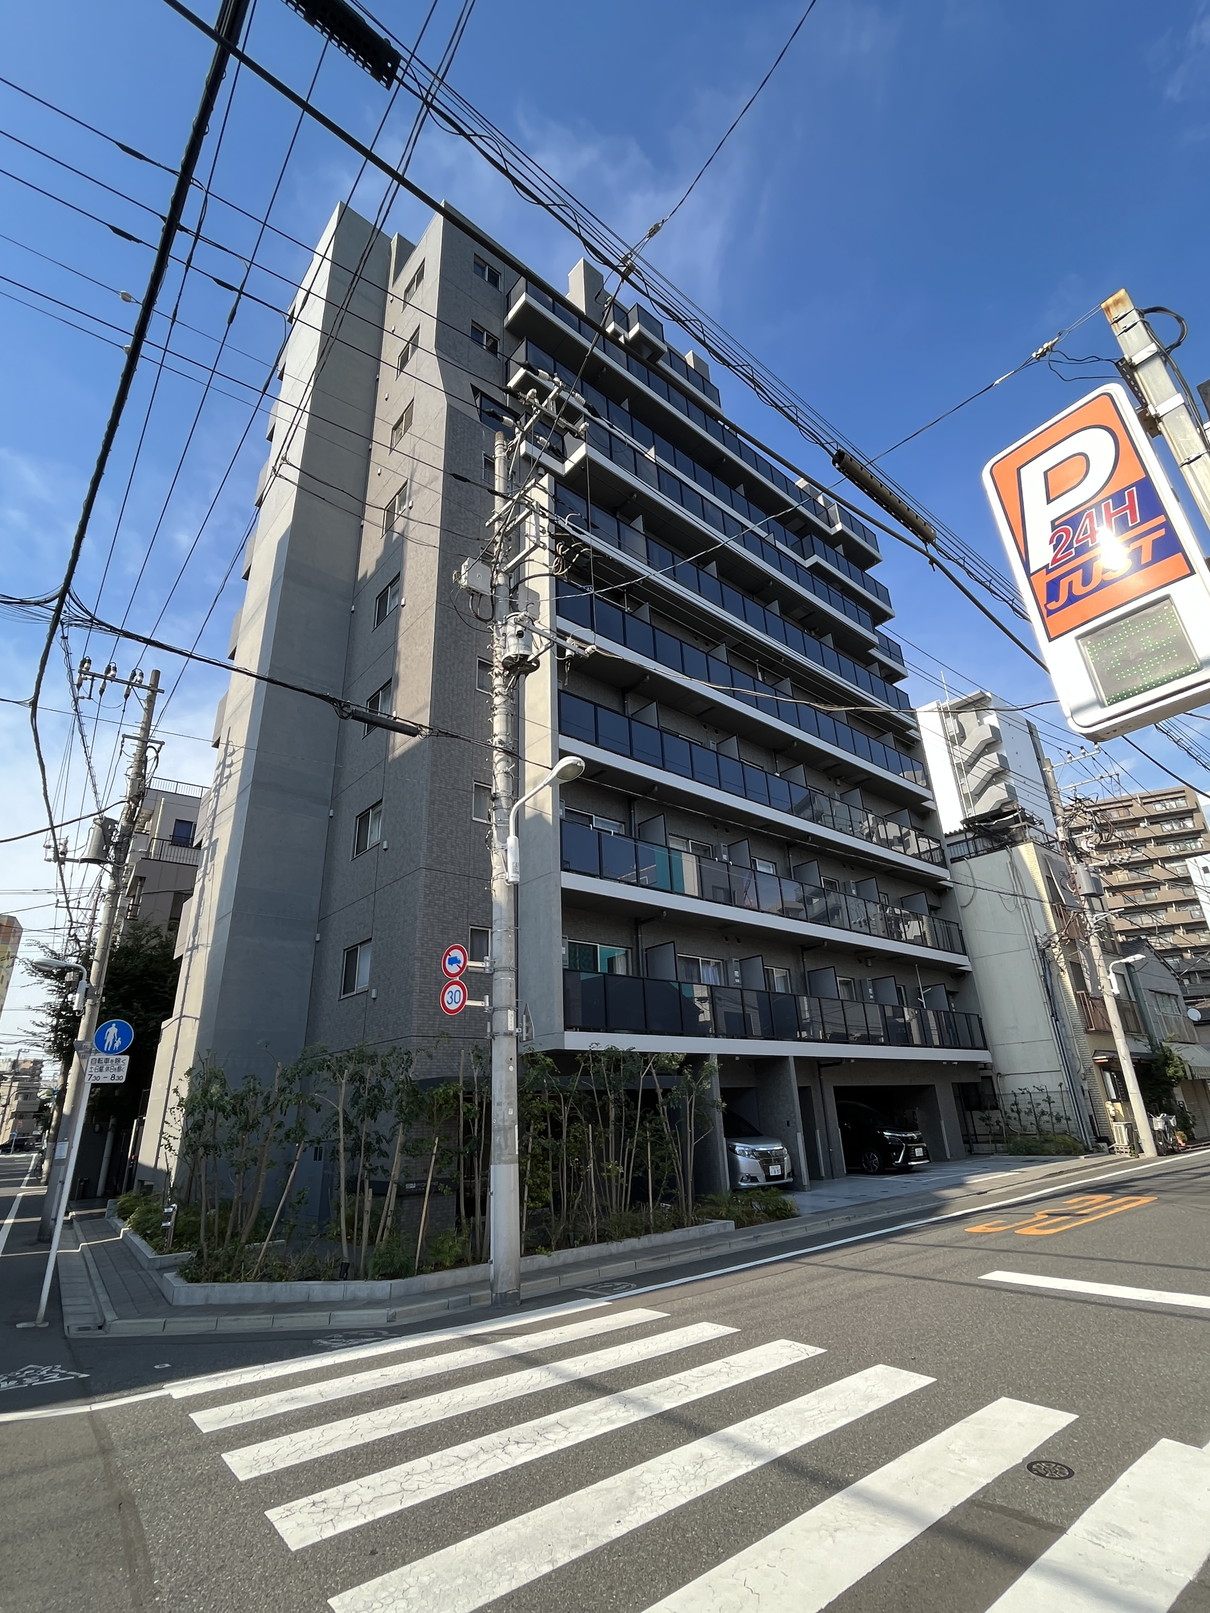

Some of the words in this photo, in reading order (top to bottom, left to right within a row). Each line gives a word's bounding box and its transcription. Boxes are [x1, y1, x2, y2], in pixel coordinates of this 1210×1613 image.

[1016, 424, 1120, 575] P
[1048, 486, 1140, 569] 24H
[447, 990, 461, 1005] 30
[964, 1196, 1158, 1235] 30
